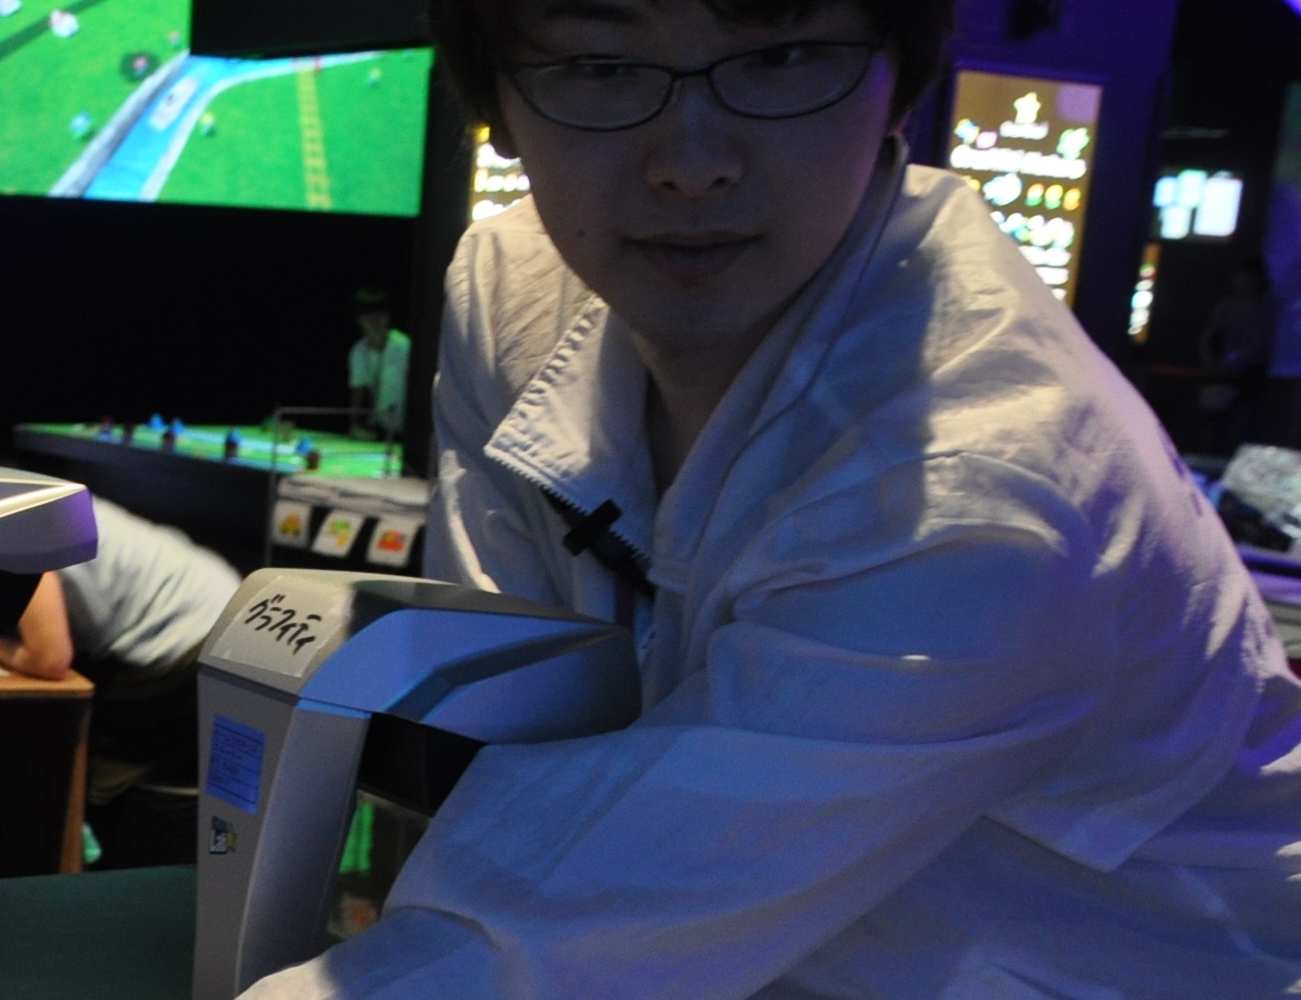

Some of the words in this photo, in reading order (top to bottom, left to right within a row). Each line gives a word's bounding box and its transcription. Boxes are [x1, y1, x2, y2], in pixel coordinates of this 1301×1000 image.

[244, 593, 322, 656] グラフィティ
